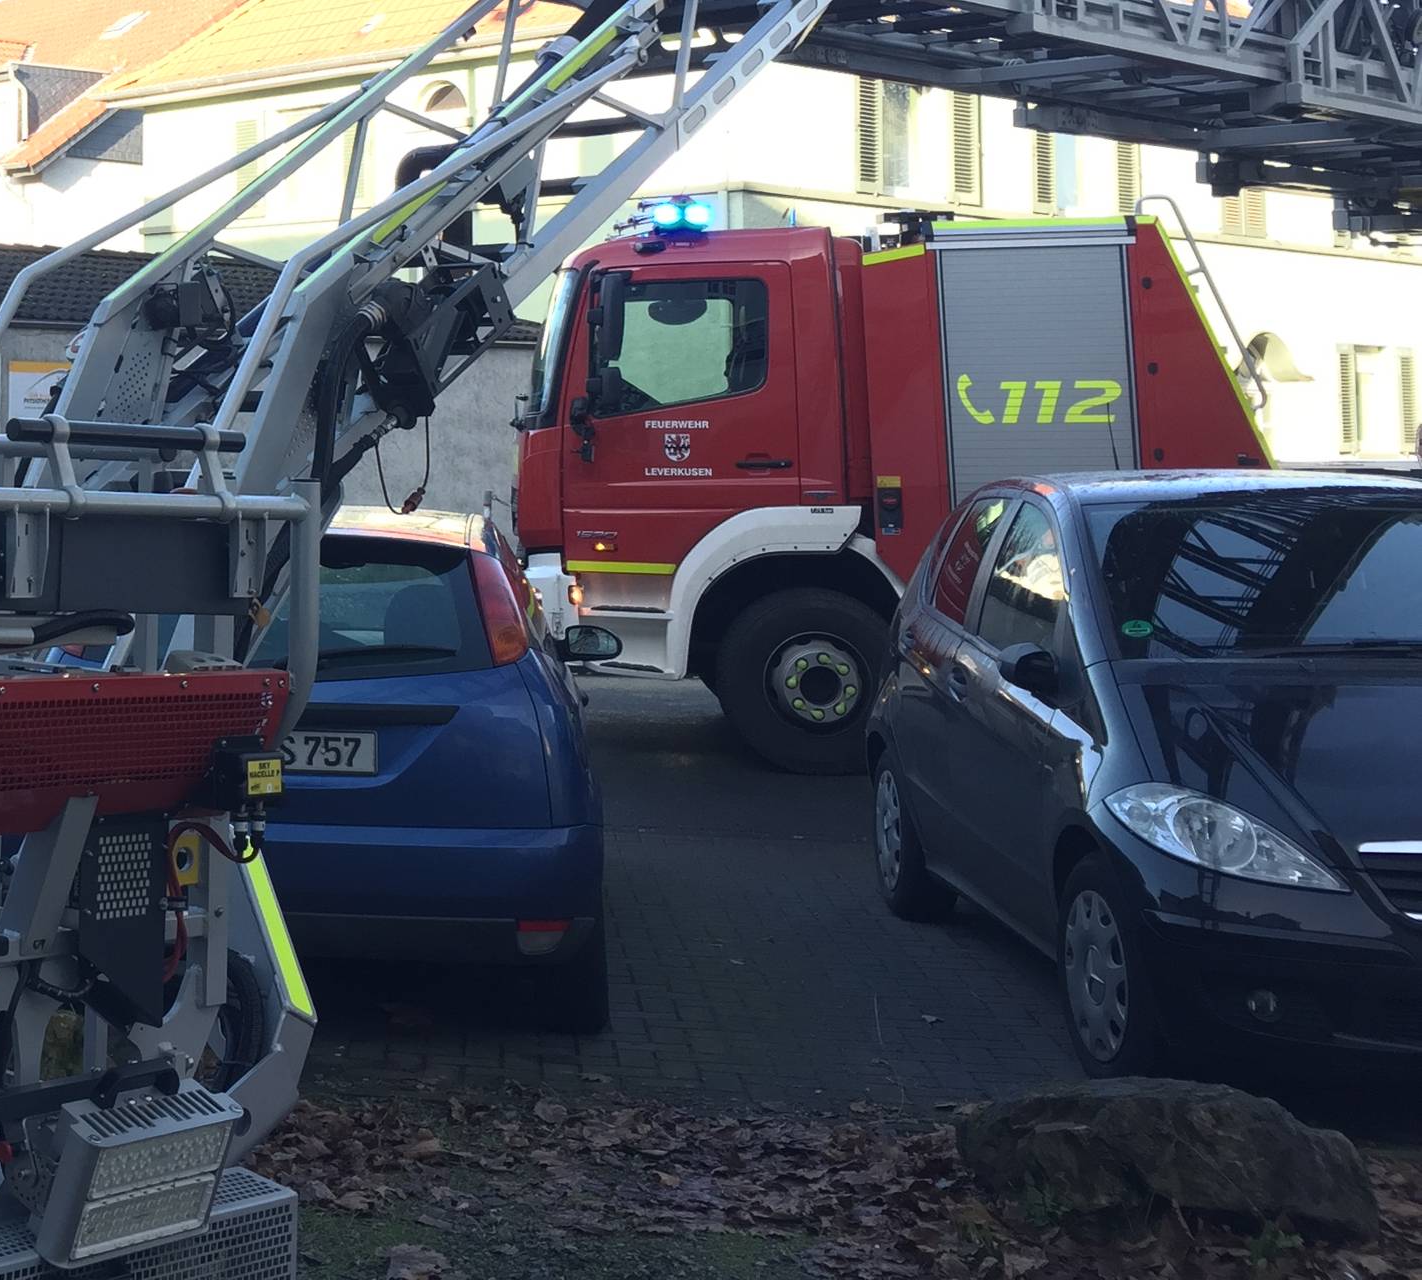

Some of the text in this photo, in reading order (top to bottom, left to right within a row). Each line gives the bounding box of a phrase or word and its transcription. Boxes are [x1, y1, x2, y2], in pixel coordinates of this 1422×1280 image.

[1000, 380, 1122, 424] 112
[644, 420, 710, 429] FEUERWEHR
[644, 468, 713, 476] LEVERKUSEN
[303, 735, 362, 769] 757
